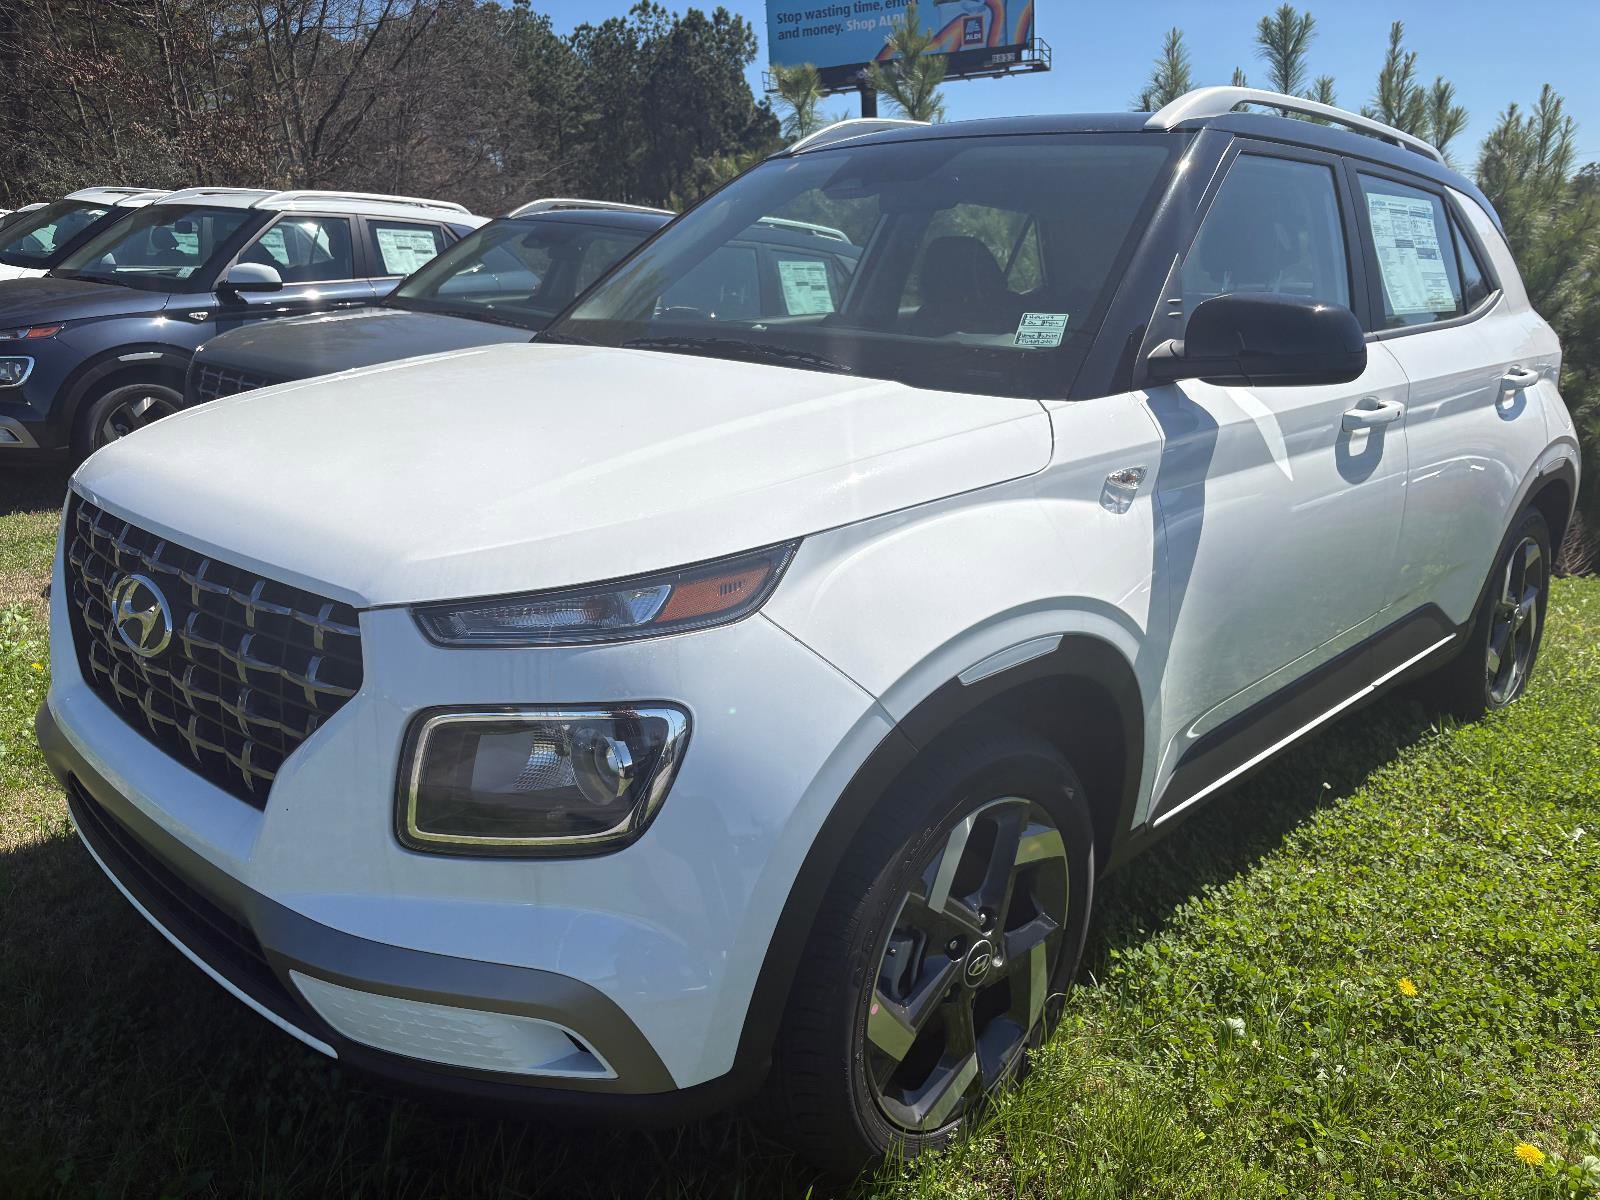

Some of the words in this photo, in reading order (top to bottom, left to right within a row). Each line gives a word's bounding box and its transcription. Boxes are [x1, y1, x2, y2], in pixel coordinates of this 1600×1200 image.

[777, 12, 802, 24] Stop
[805, 4, 851, 20] wasting
[854, 1, 883, 12] time,
[778, 26, 800, 40] and
[802, 23, 844, 36] money.
[847, 19, 876, 32] Shop
[965, 32, 981, 40] ALDI
